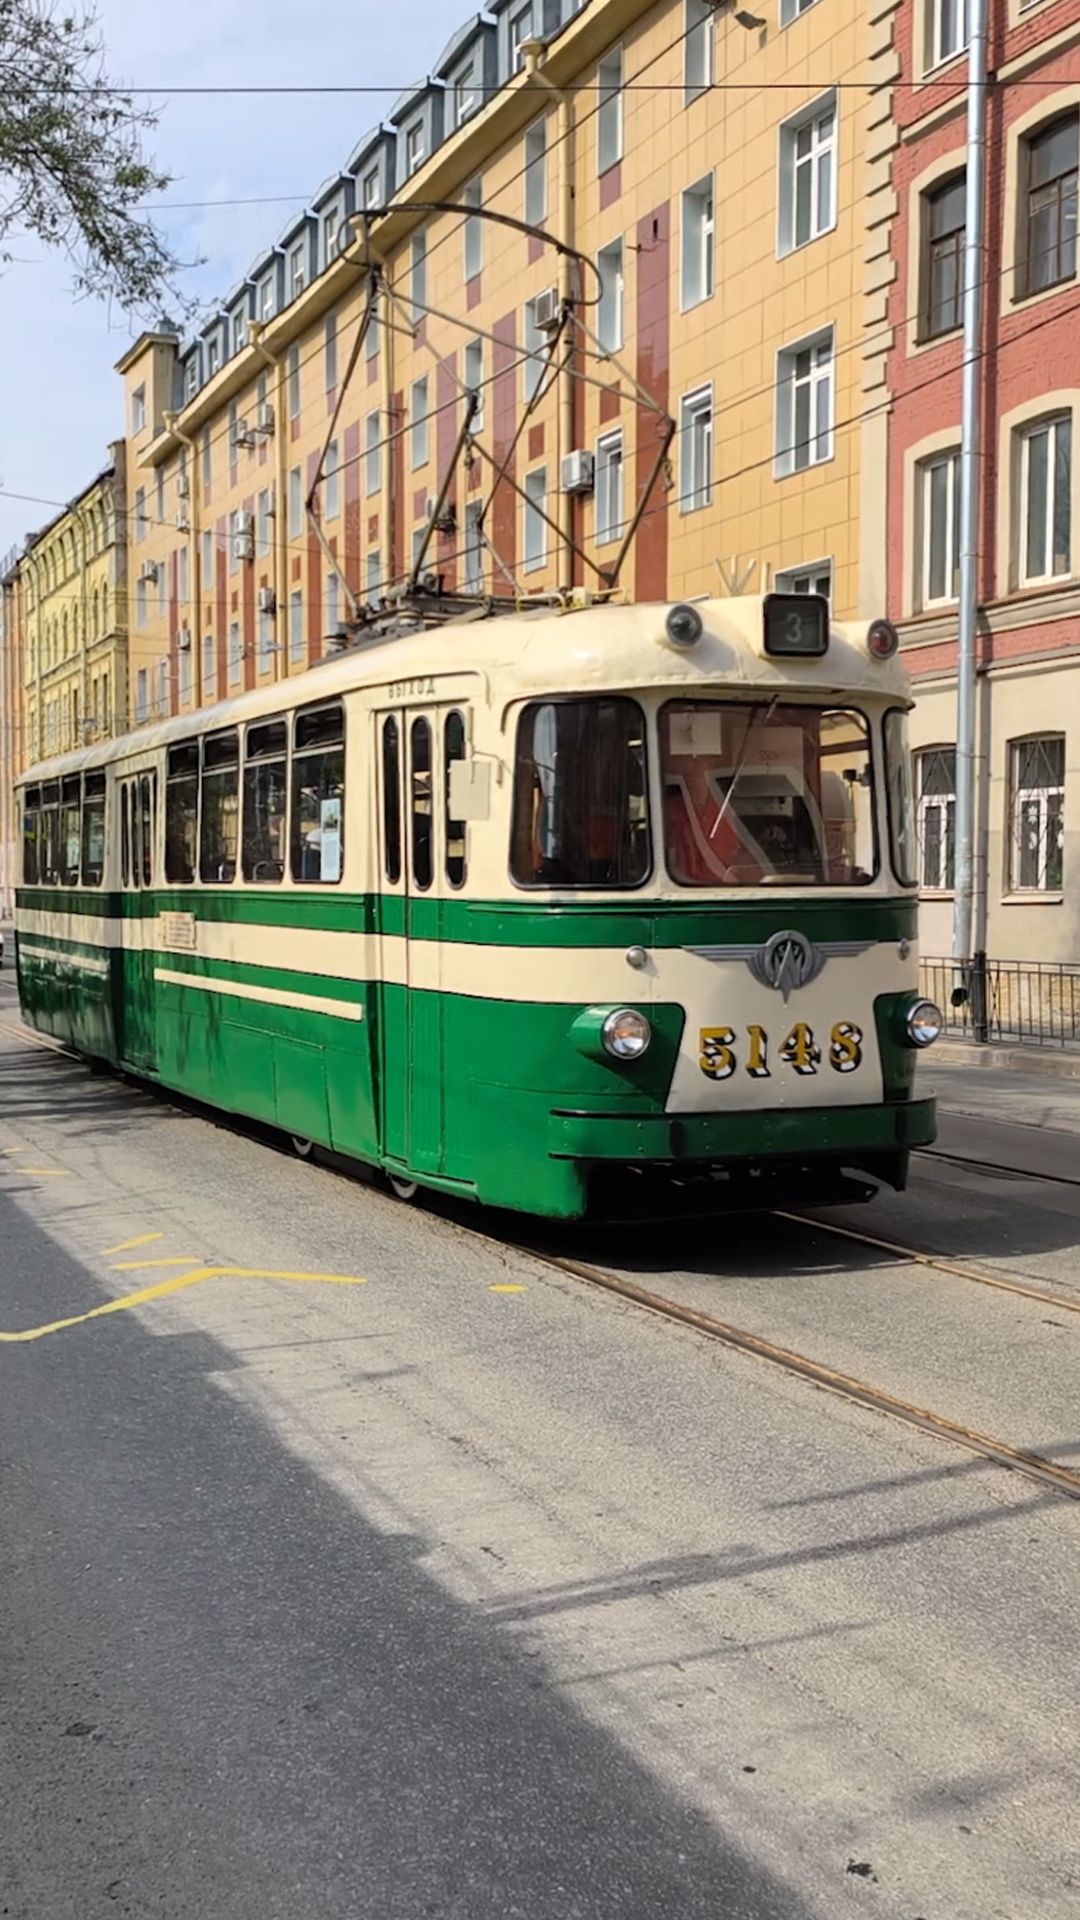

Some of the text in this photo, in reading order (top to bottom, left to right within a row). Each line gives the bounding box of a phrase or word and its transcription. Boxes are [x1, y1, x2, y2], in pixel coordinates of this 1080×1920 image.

[785, 612, 802, 643] 3
[388, 678, 436, 700] ВЫХОД
[699, 1020, 863, 1081] 5148
